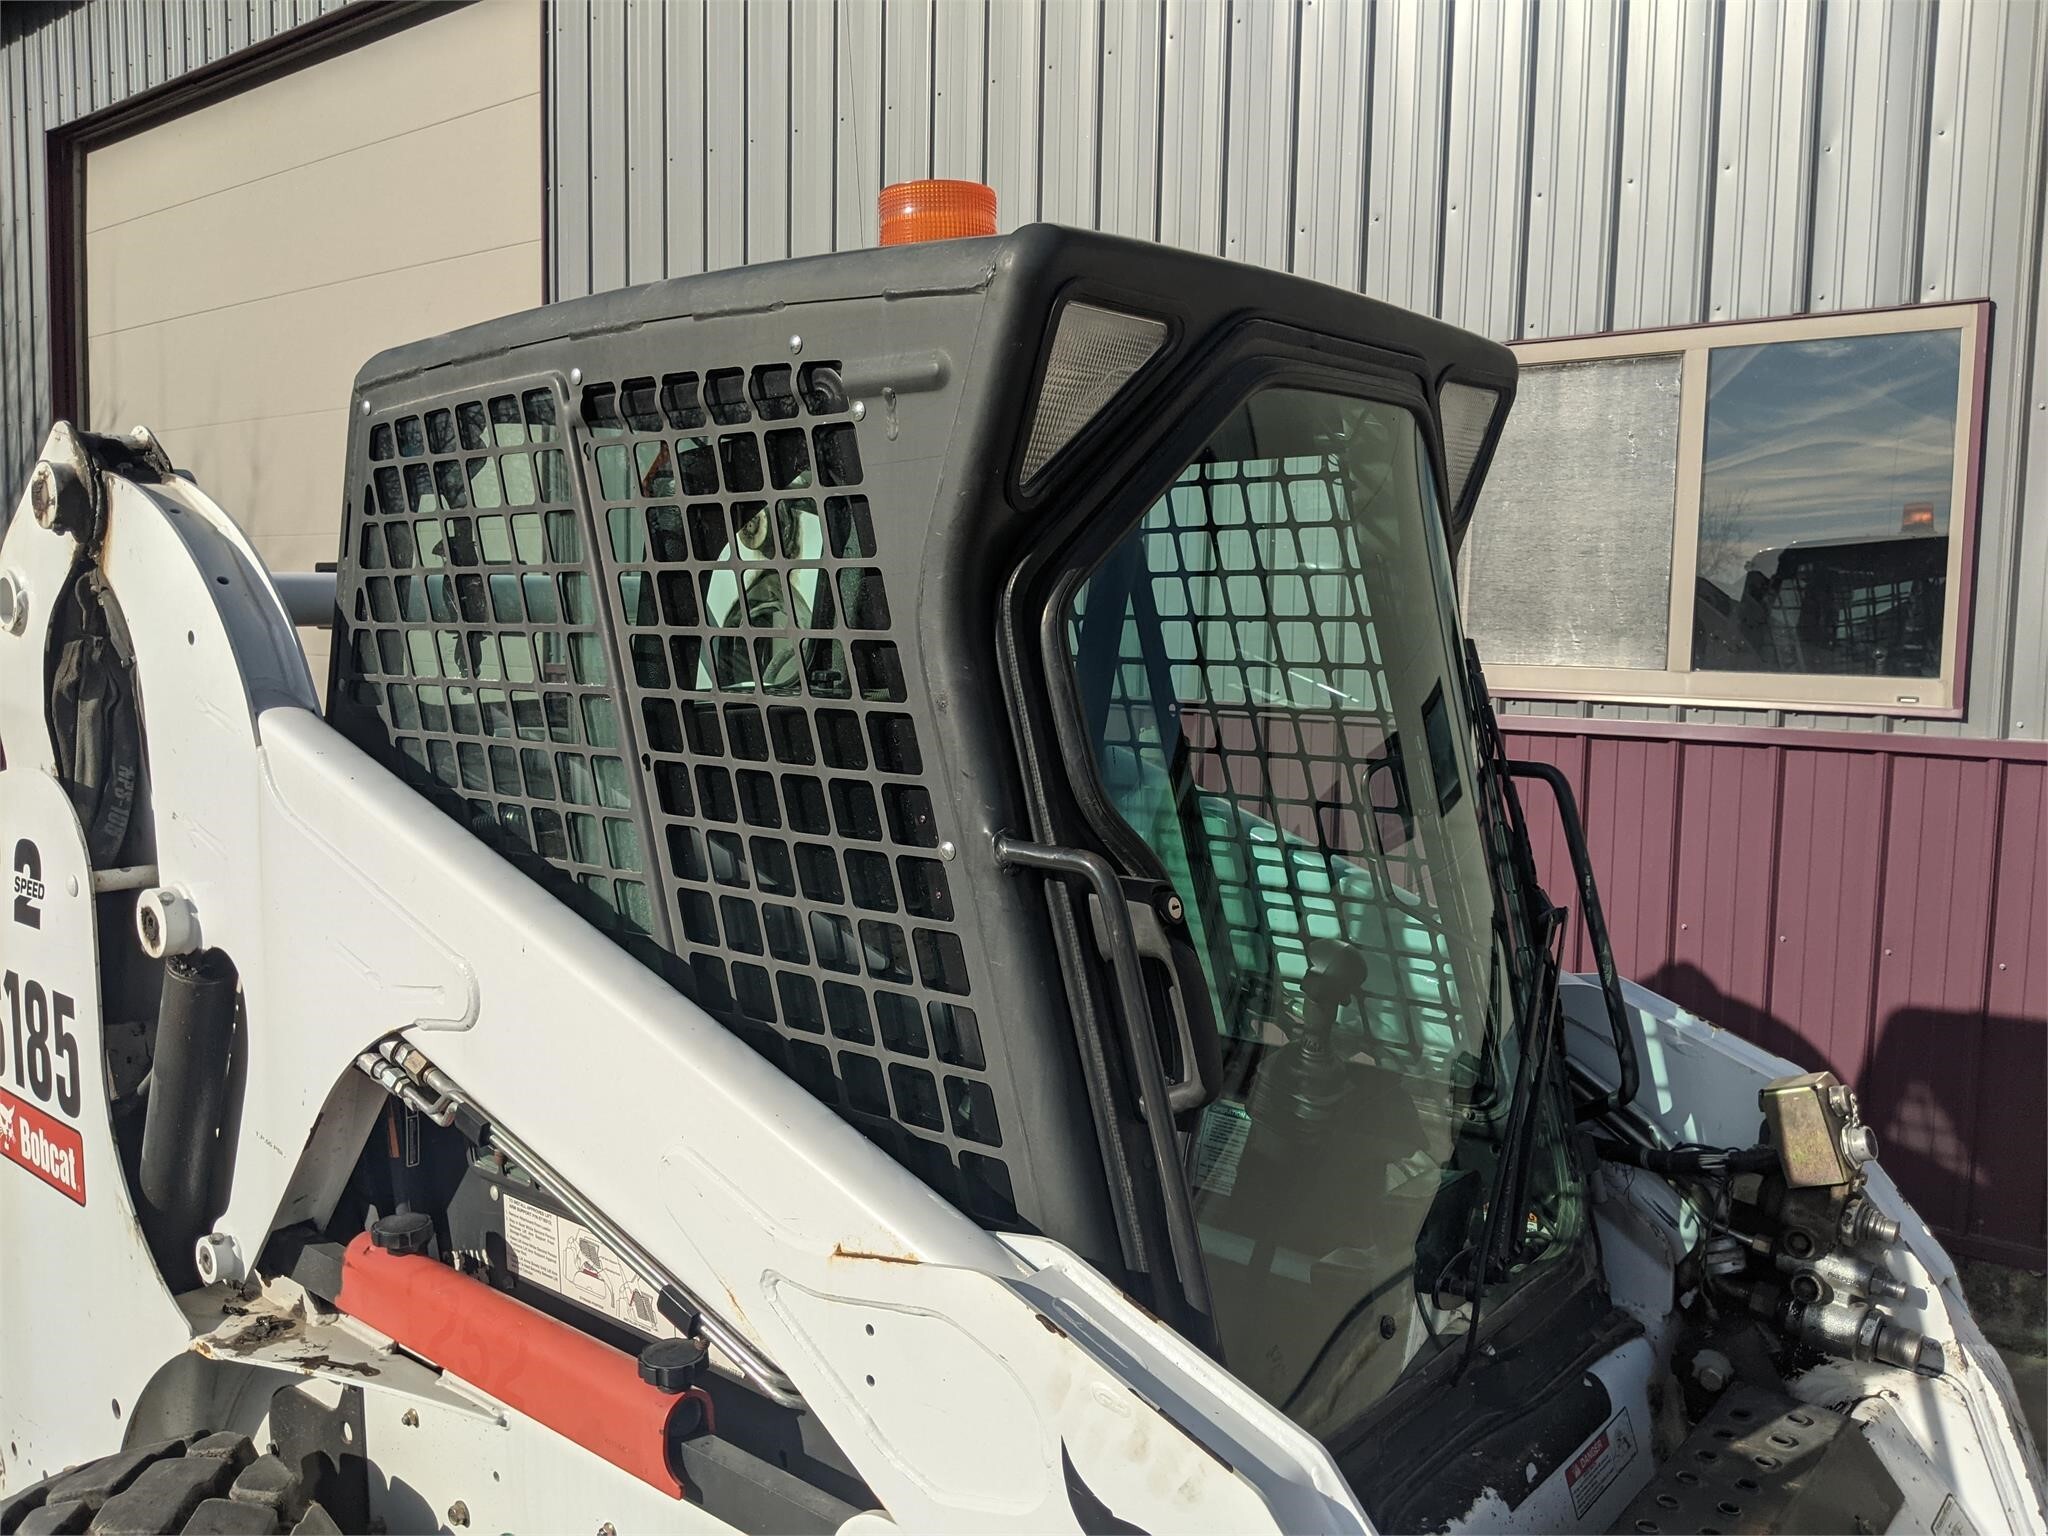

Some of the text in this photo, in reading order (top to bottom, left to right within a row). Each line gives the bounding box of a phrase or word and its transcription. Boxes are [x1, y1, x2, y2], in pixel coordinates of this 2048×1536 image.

[14, 838, 42, 930] 2
[14, 875, 45, 901] SPEED
[0, 969, 81, 1118] 185
[19, 1116, 77, 1191] Bobcat
